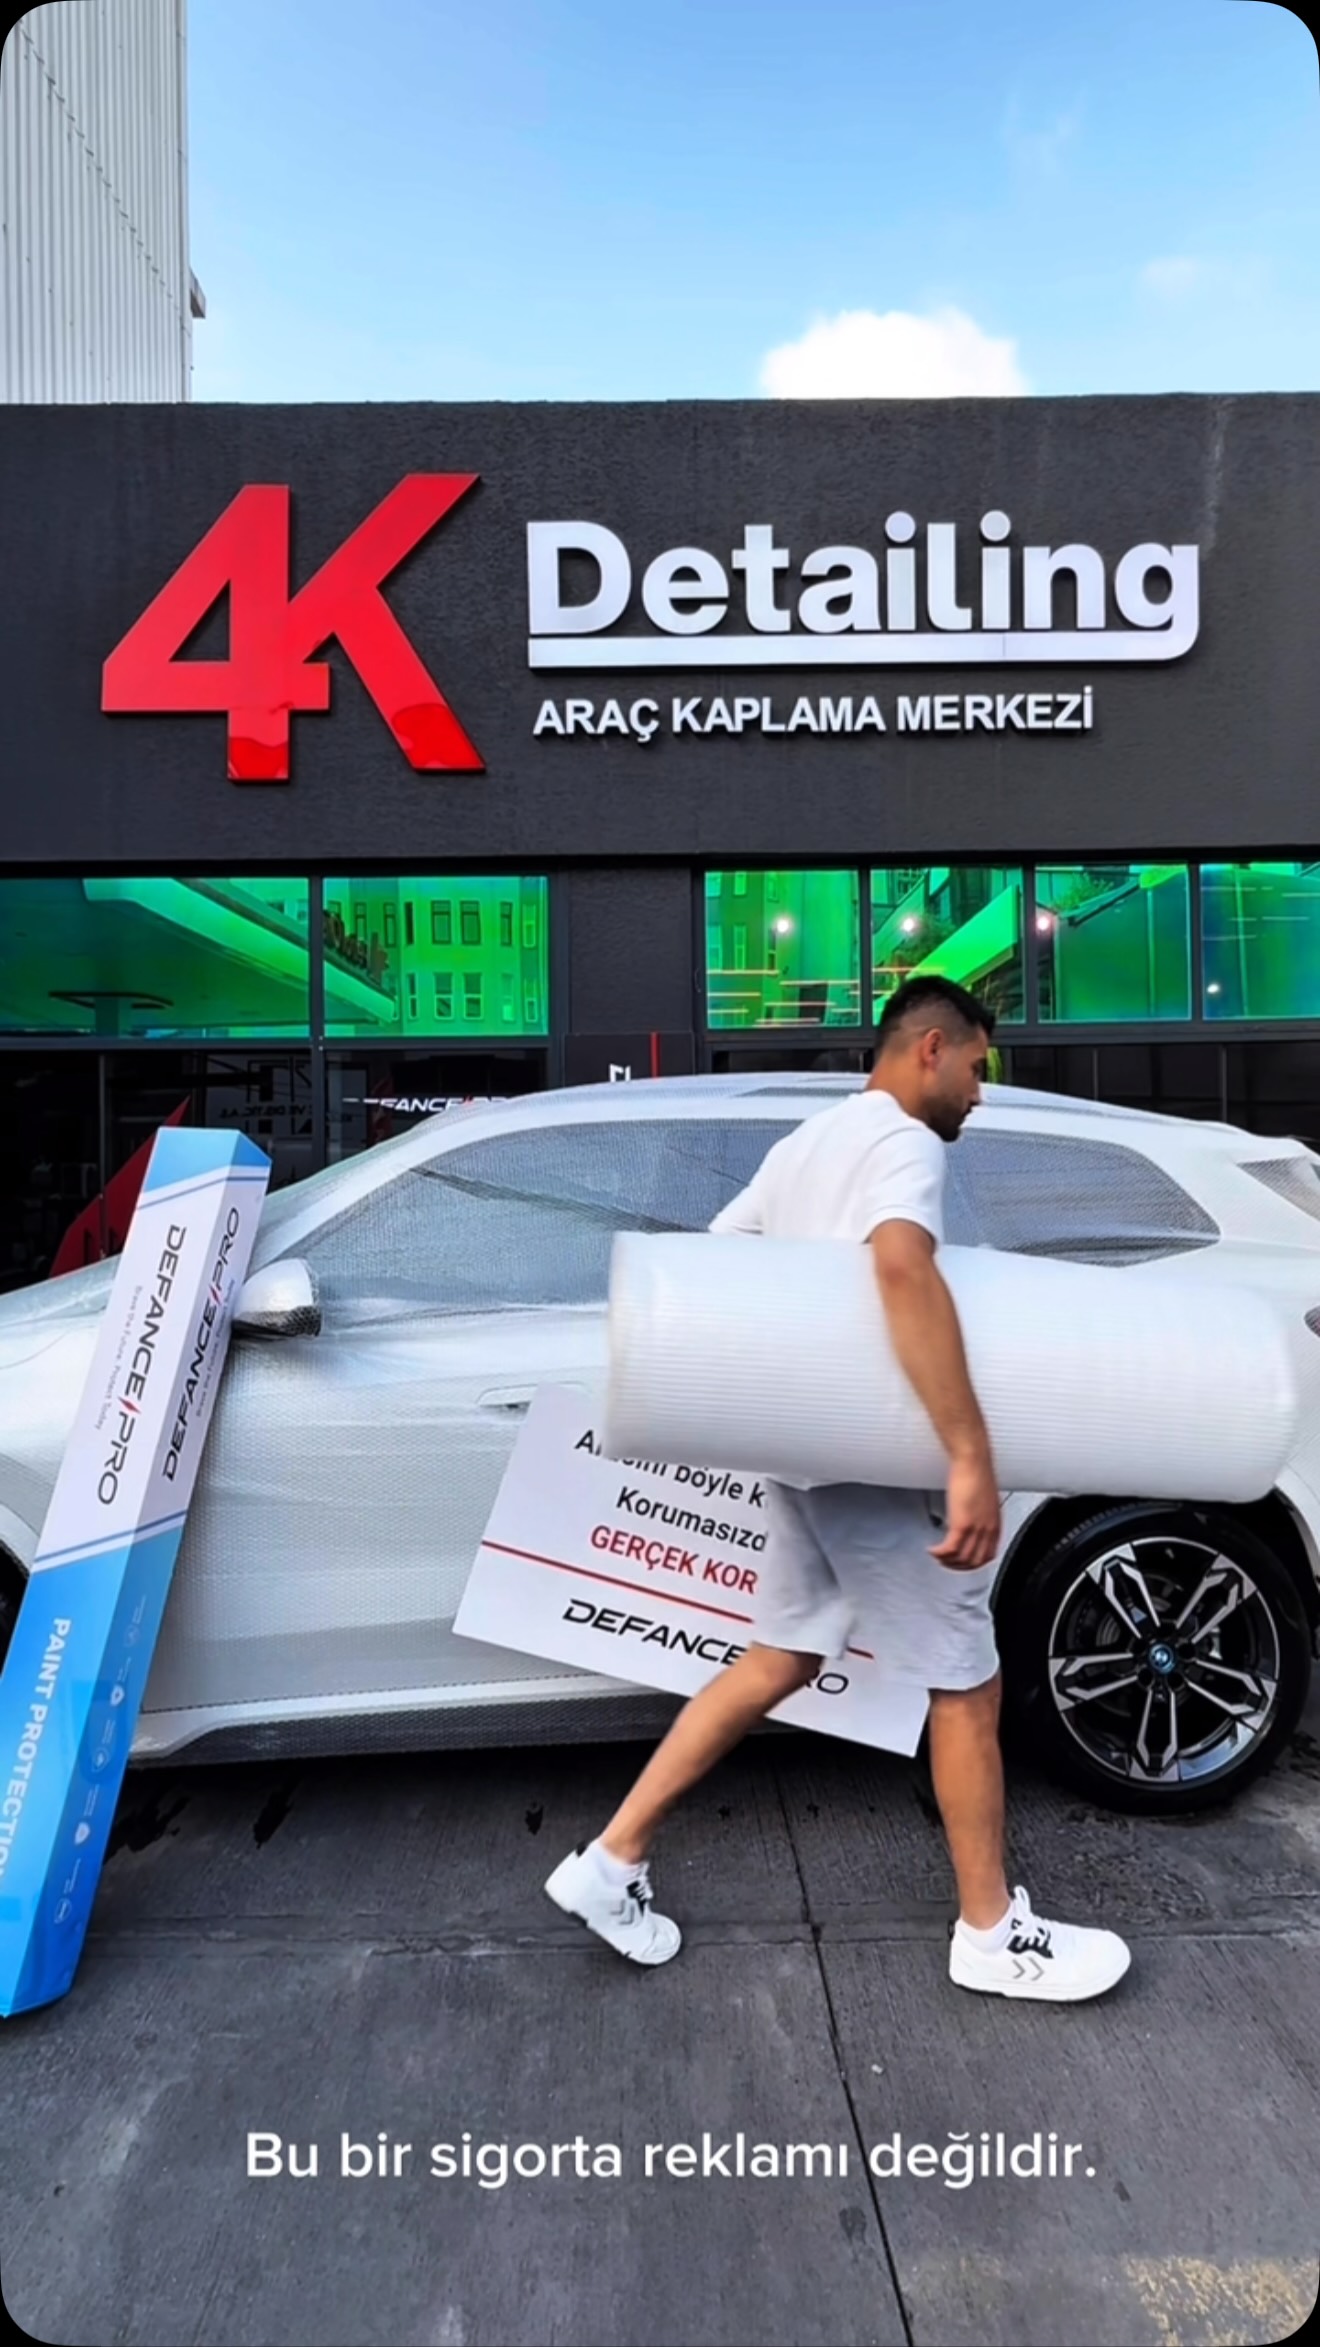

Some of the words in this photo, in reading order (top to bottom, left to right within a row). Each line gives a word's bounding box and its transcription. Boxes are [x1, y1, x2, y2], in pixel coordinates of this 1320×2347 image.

[101, 472, 486, 782] 4K
[527, 510, 1200, 666] Detailing
[533, 699, 659, 742] ARAÇ
[671, 697, 886, 733] KAPLAMA
[896, 686, 1094, 731] MERKEZİ
[616, 1486, 769, 1552] Korumasızd
[590, 1524, 700, 1576] GERÇEK
[702, 1557, 759, 1595] KOR
[35, 1618, 72, 1700] PAINT
[0, 1703, 49, 1877] PROTECTI
